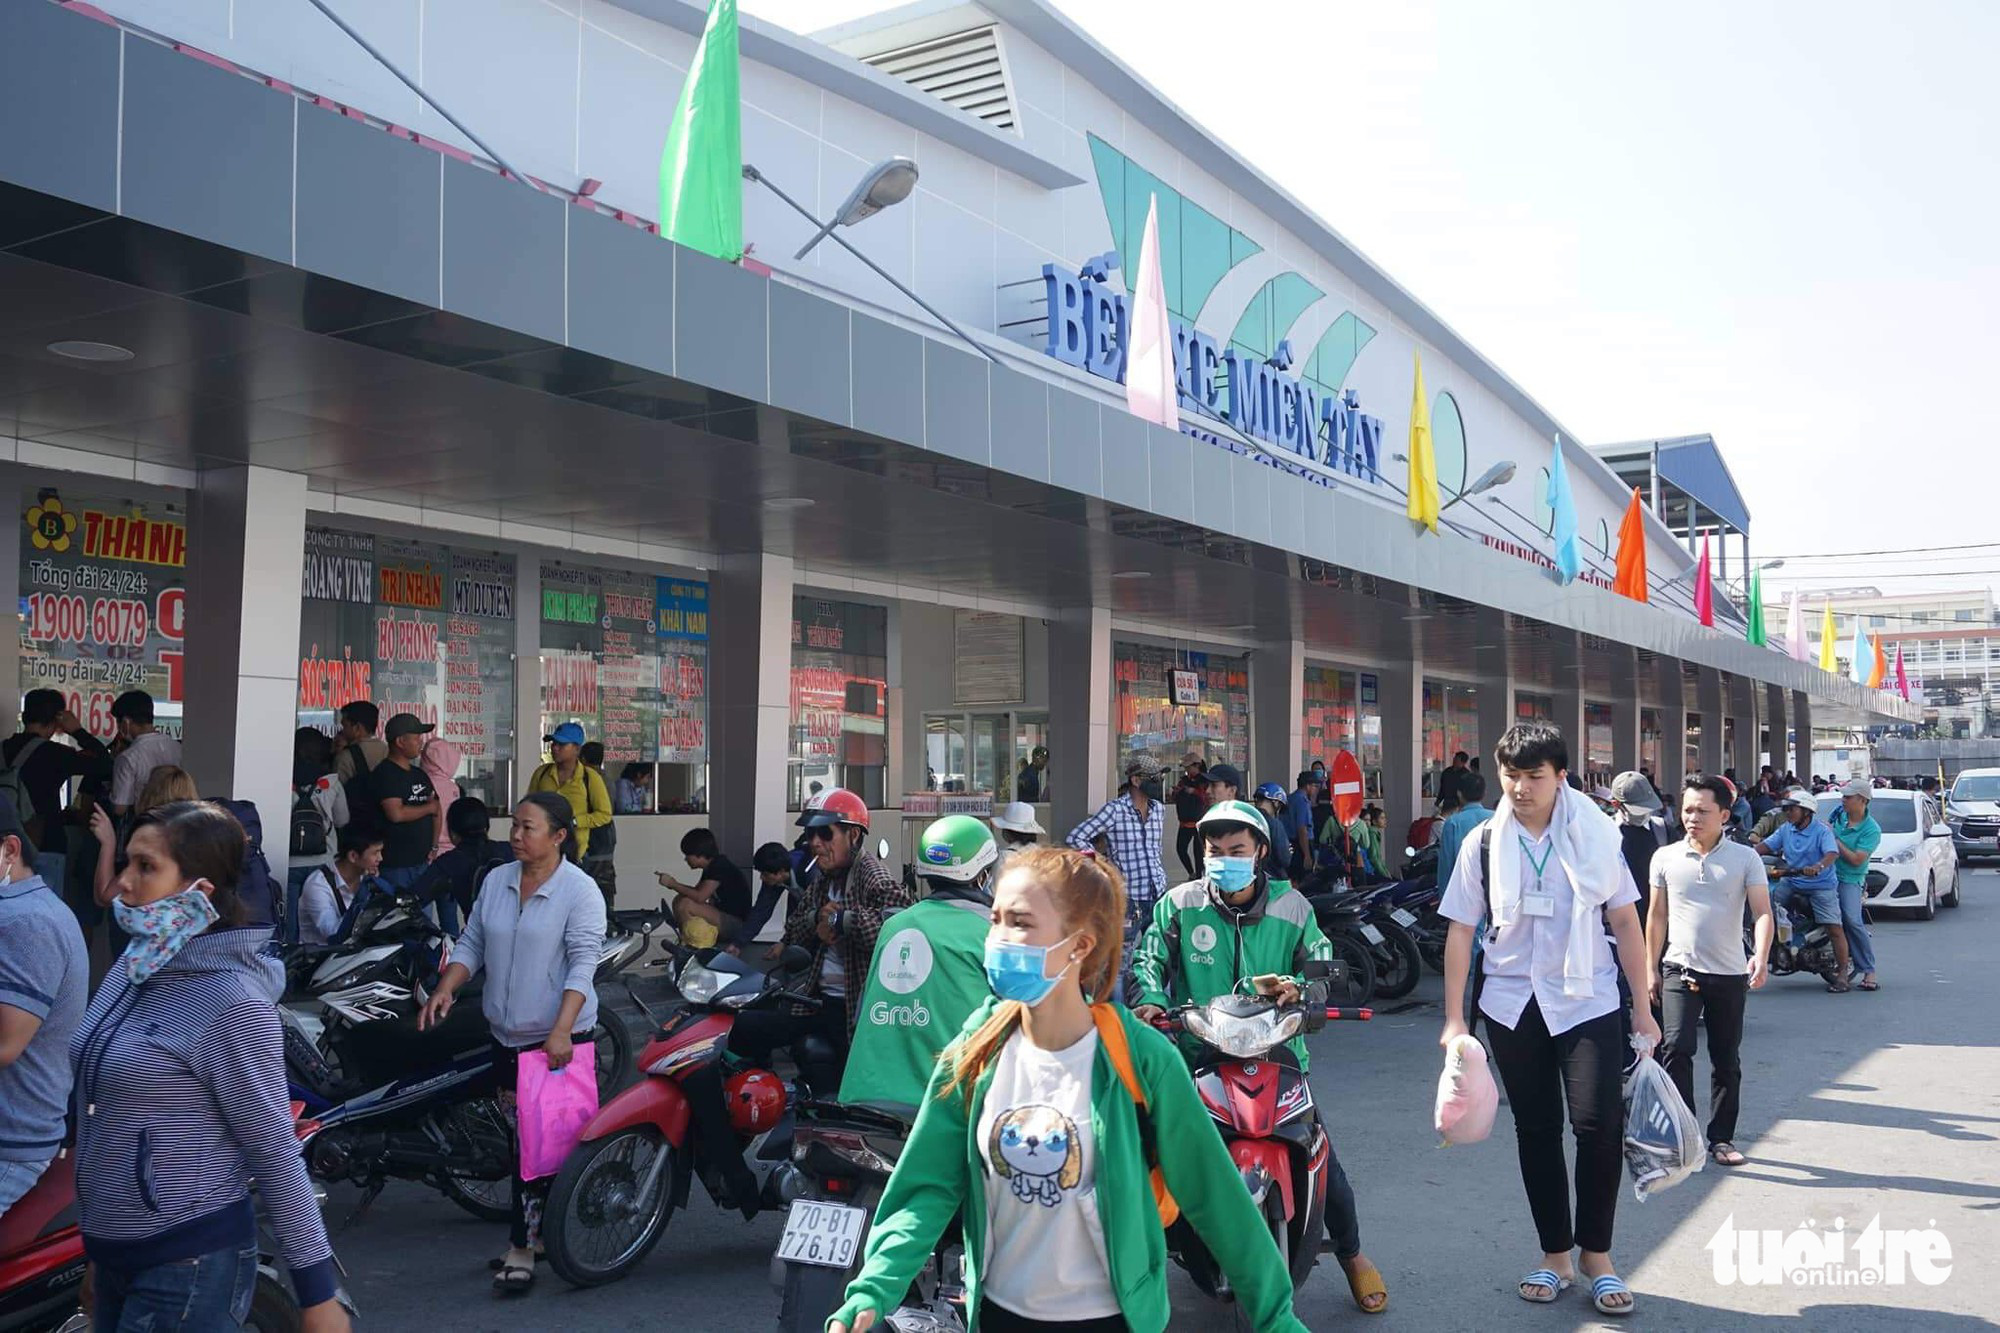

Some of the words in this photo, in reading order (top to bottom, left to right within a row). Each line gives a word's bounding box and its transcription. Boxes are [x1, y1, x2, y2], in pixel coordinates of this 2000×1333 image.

[1223, 339, 1321, 462] MIỀN
[1320, 388, 1385, 485] TÂY
[349, 537, 373, 551] TNHH
[30, 558, 69, 592] Tổng
[75, 567, 98, 588] đài
[101, 569, 148, 594] 24/24:
[345, 557, 373, 604] VINH
[28, 592, 87, 643] 1900
[92, 597, 148, 647] 6079
[29, 655, 67, 684] Tổng
[71, 661, 95, 682] đài
[101, 661, 147, 685] 24/24:
[1911, 680, 1921, 689] XE
[1190, 952, 1215, 966] Grab
[869, 999, 930, 1027] Grab
[797, 1205, 852, 1235] 70-B1
[780, 1231, 853, 1263] 776.19
